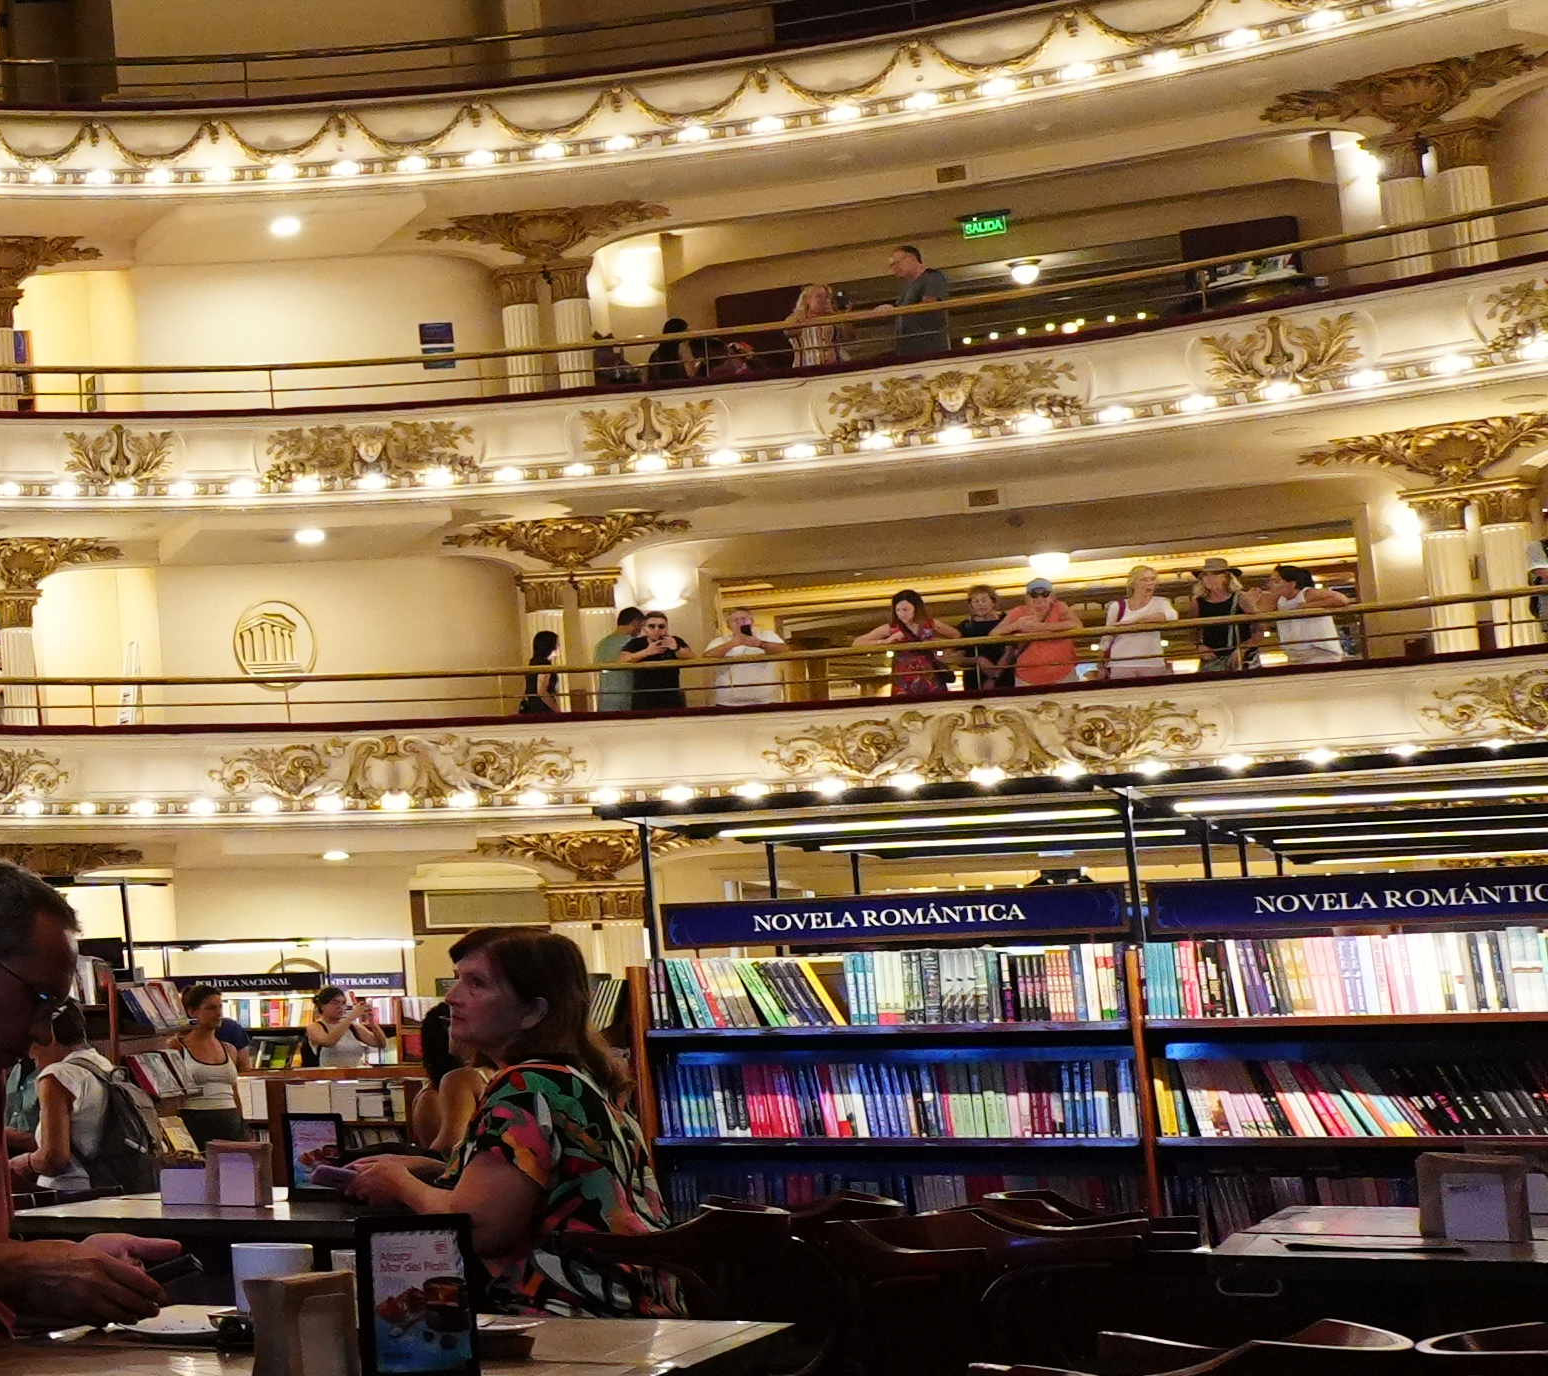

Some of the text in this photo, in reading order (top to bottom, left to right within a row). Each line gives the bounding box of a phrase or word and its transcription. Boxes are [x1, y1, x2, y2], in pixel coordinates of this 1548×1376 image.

[964, 218, 1004, 236] SALIDA
[1253, 881, 1548, 915] NOVELA ROMÁNTIC
[753, 902, 1027, 932] NOVELA ROMÁNTICA
[195, 976, 291, 988] POLÍTICA NACIONAL
